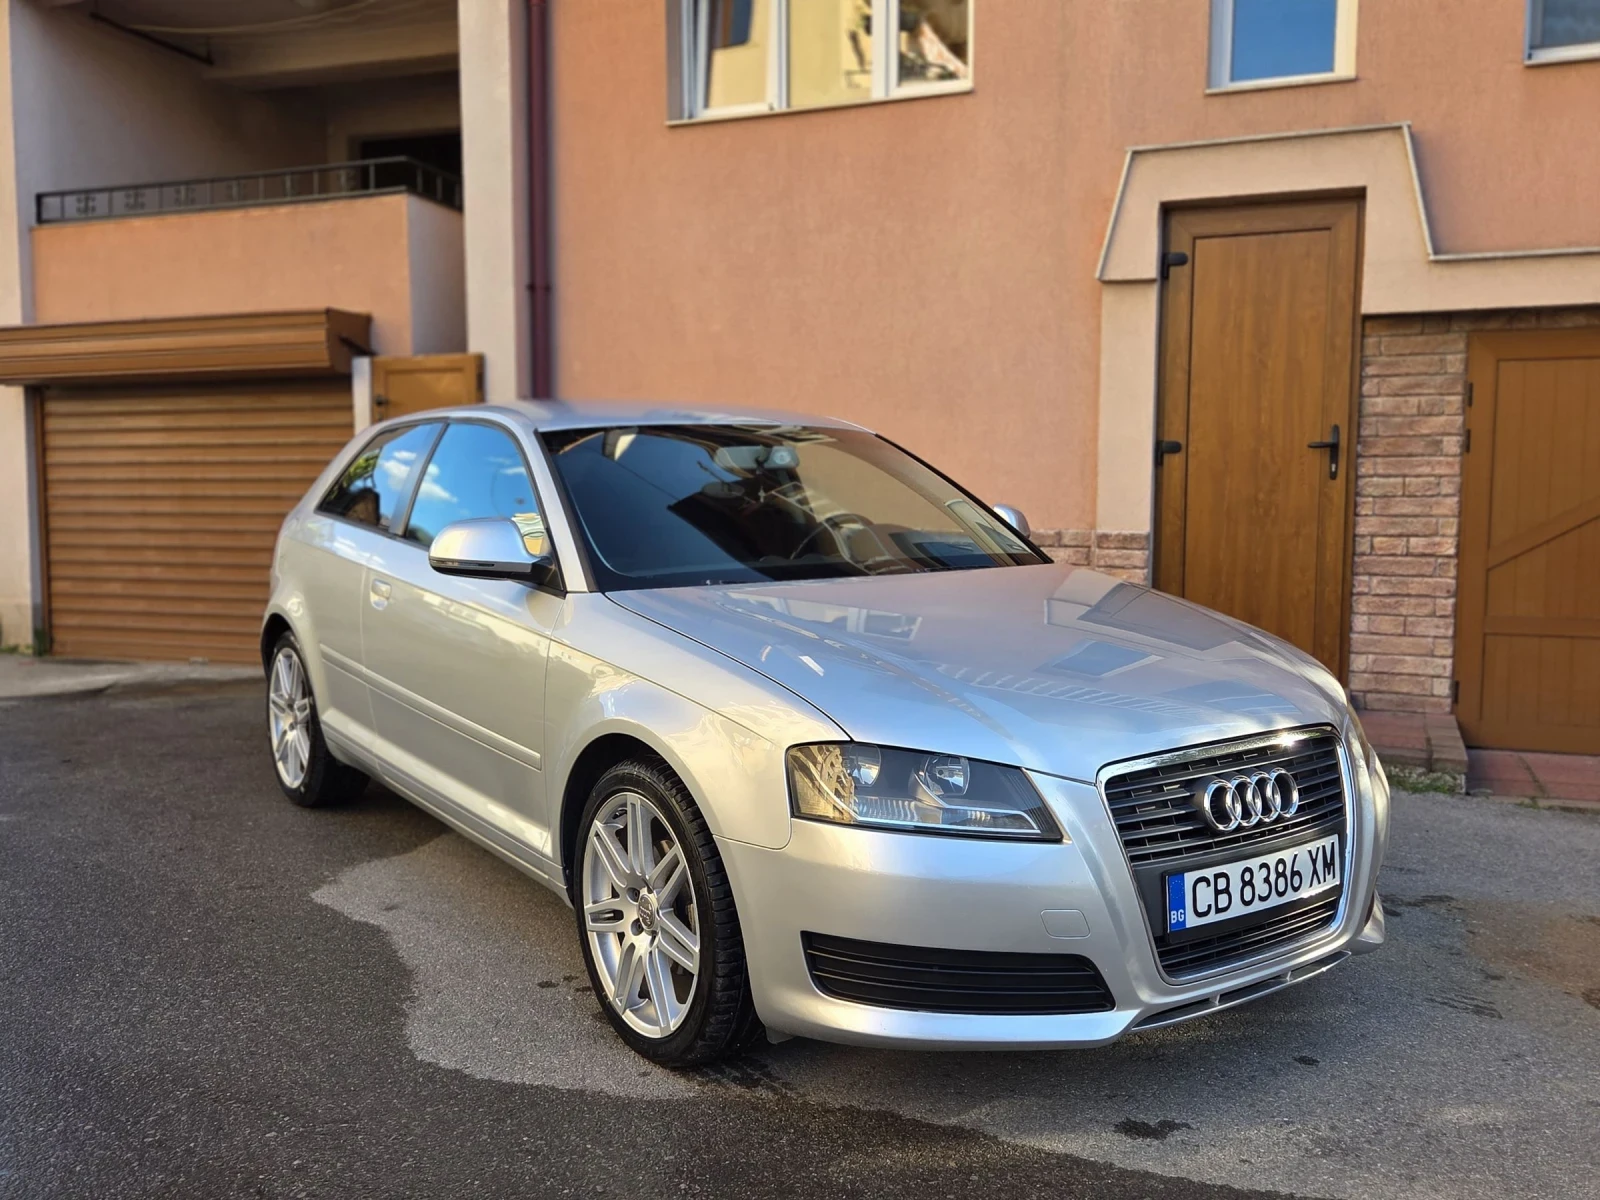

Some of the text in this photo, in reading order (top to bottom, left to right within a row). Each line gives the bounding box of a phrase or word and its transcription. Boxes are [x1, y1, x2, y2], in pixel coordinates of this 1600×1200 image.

[1192, 840, 1336, 918] CB 8386 XM
[1170, 910, 1185, 924] BG
